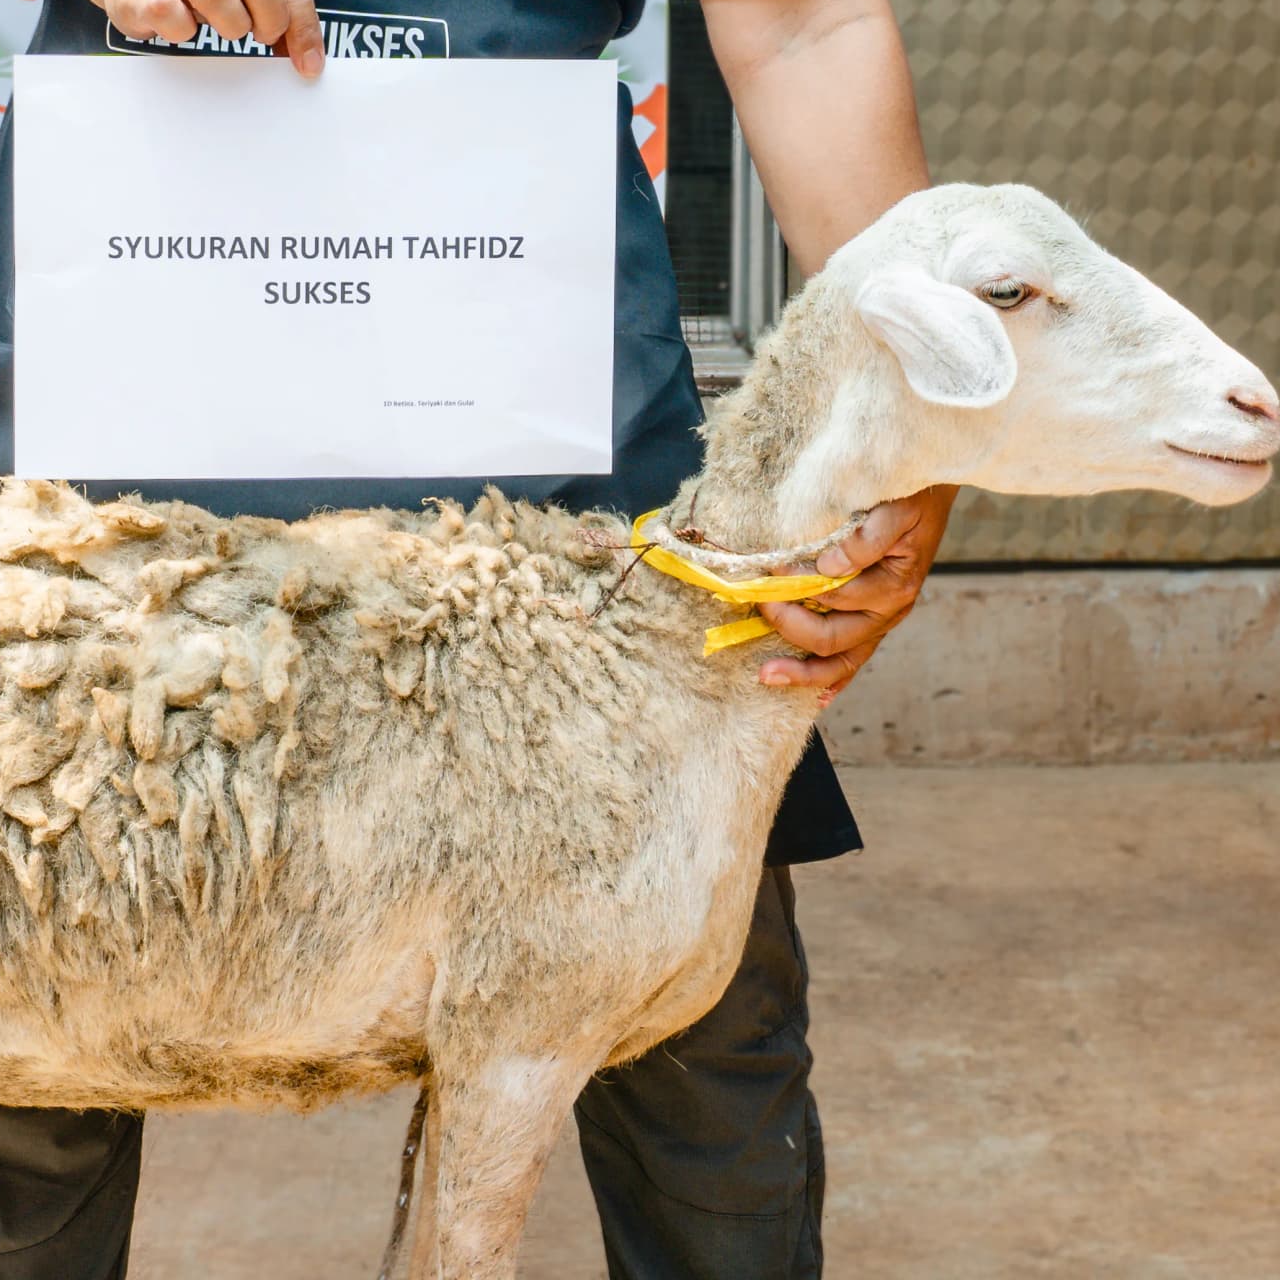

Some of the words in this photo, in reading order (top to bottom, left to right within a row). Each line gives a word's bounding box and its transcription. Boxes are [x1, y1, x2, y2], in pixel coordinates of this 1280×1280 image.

[108, 236, 270, 260] SYUKURAN
[281, 236, 393, 260] RUMAH
[402, 236, 525, 260] TAHFIDZ
[264, 281, 371, 305] SUKSES
